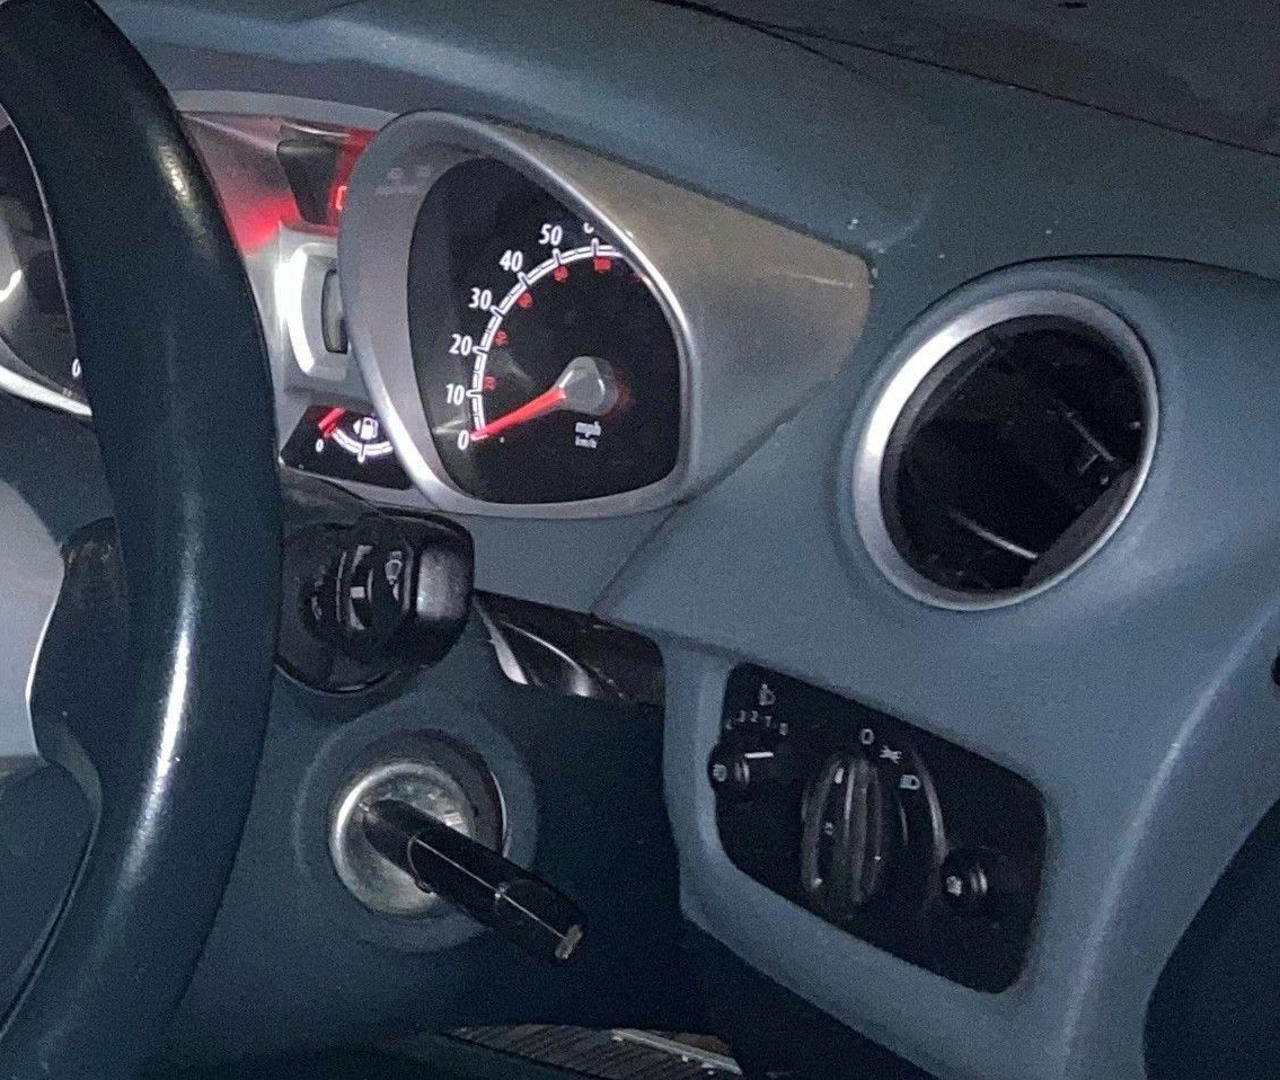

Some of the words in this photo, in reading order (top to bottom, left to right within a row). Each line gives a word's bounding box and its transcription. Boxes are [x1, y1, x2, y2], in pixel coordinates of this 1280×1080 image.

[538, 223, 563, 246] 50
[498, 249, 524, 273] 40
[468, 287, 493, 311] 30
[448, 333, 474, 357] 20
[445, 383, 465, 406] 10
[315, 438, 325, 453] 0
[457, 429, 470, 451] 0
